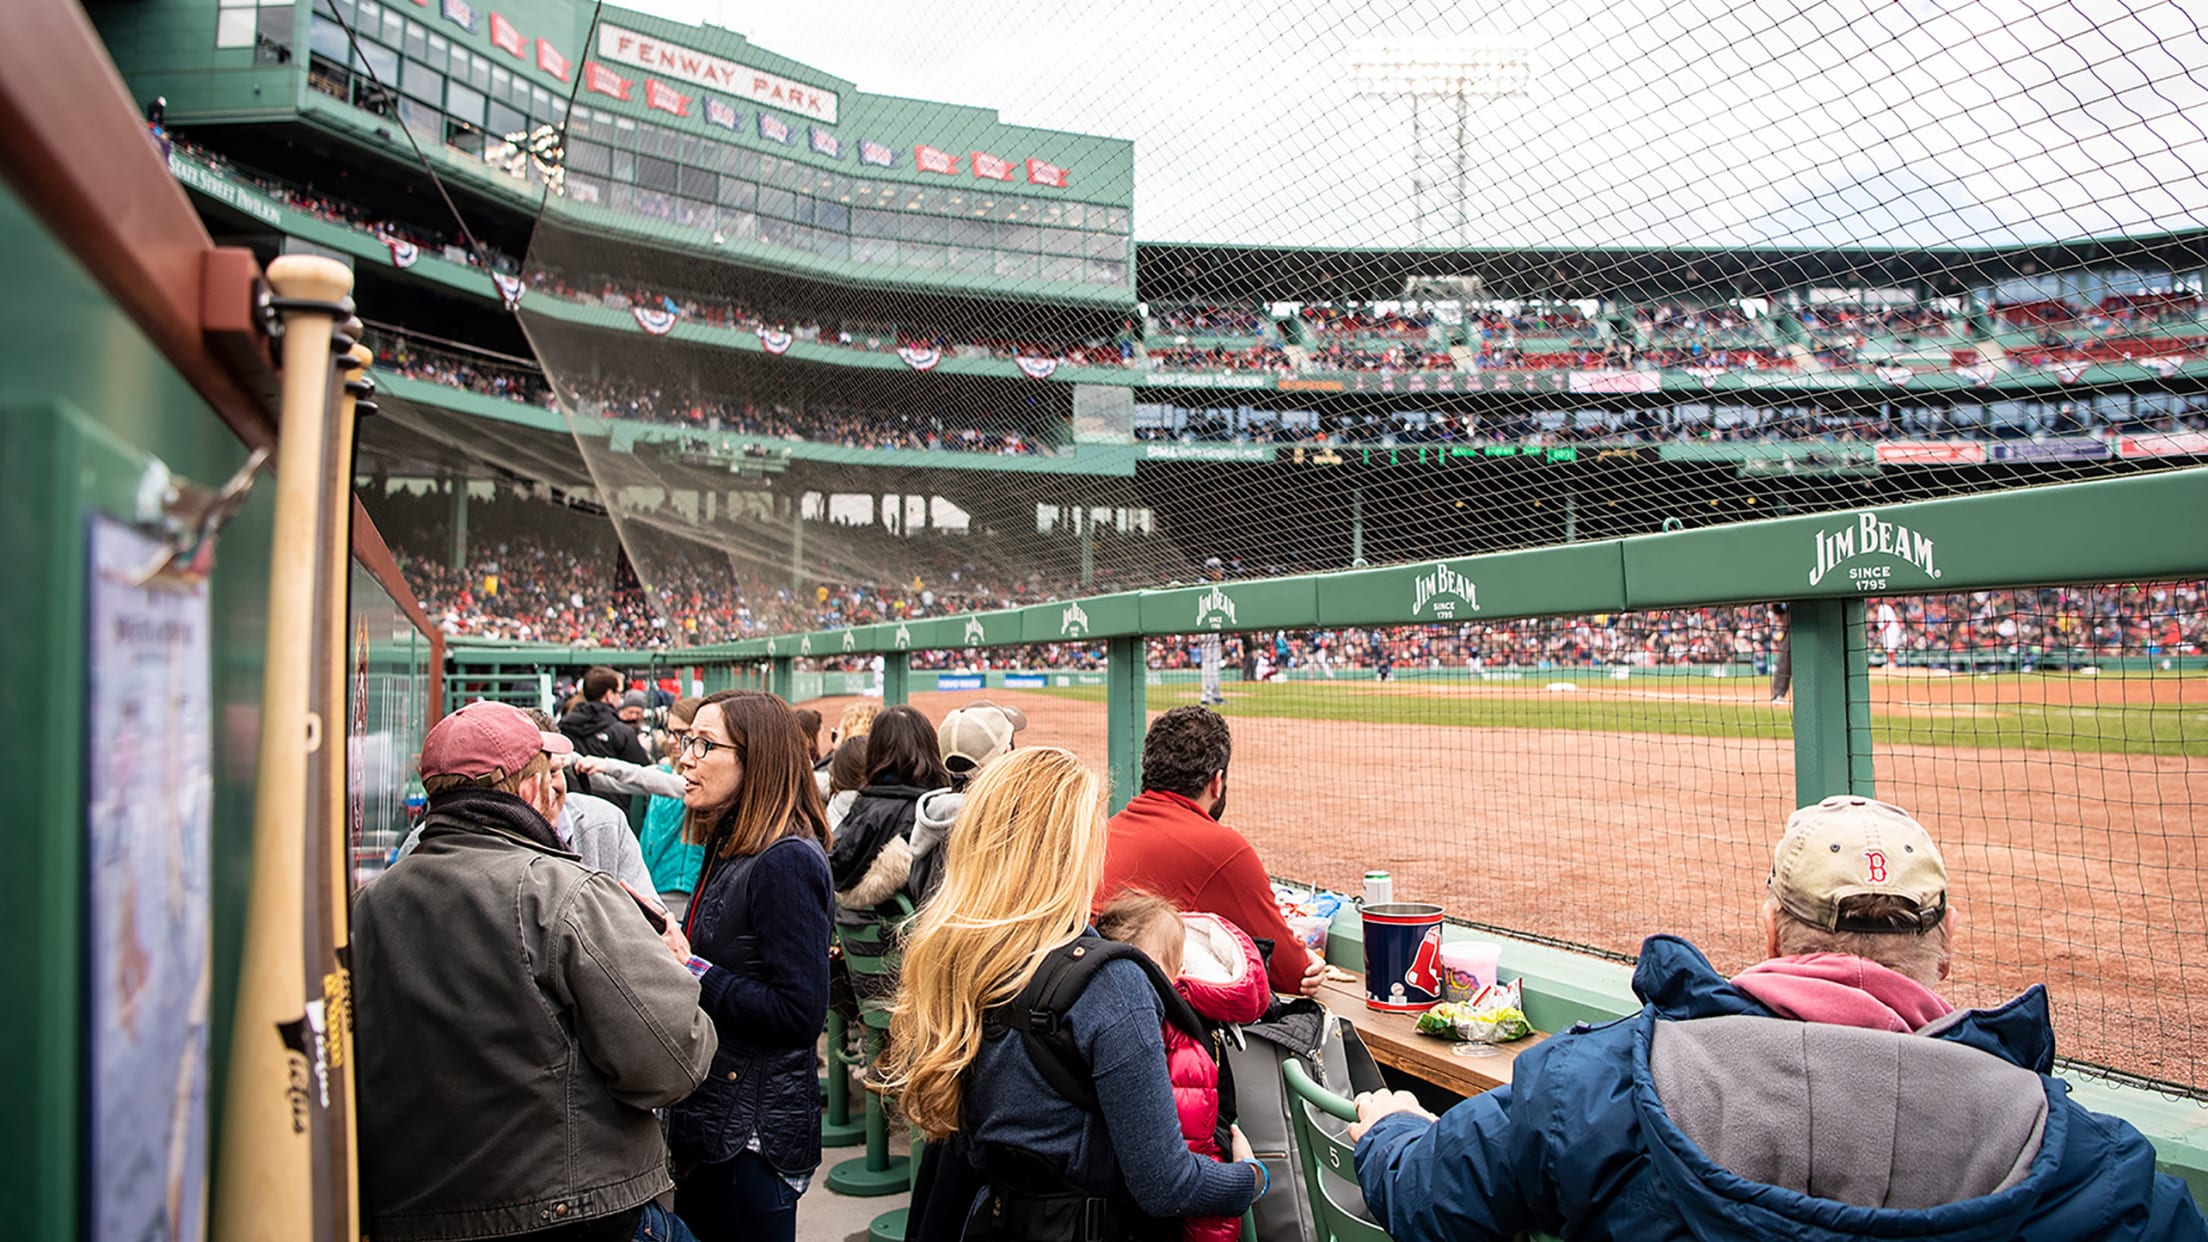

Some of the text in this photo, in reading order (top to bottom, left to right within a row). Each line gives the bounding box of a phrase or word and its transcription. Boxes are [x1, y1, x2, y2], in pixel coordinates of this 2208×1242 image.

[618, 35, 736, 85] FENWAY
[752, 77, 822, 113] PARK
[168, 151, 281, 225] STATE STREET PAVILION
[1809, 512, 1936, 586] JIM BEAM
[1849, 566, 1891, 579] SINCE
[1855, 579, 1886, 591] 1795
[1412, 563, 1477, 616] JIM BEAM
[1433, 602, 1455, 612] SINCE
[1864, 851, 1887, 883] B
[1329, 1145, 1340, 1168] 5
